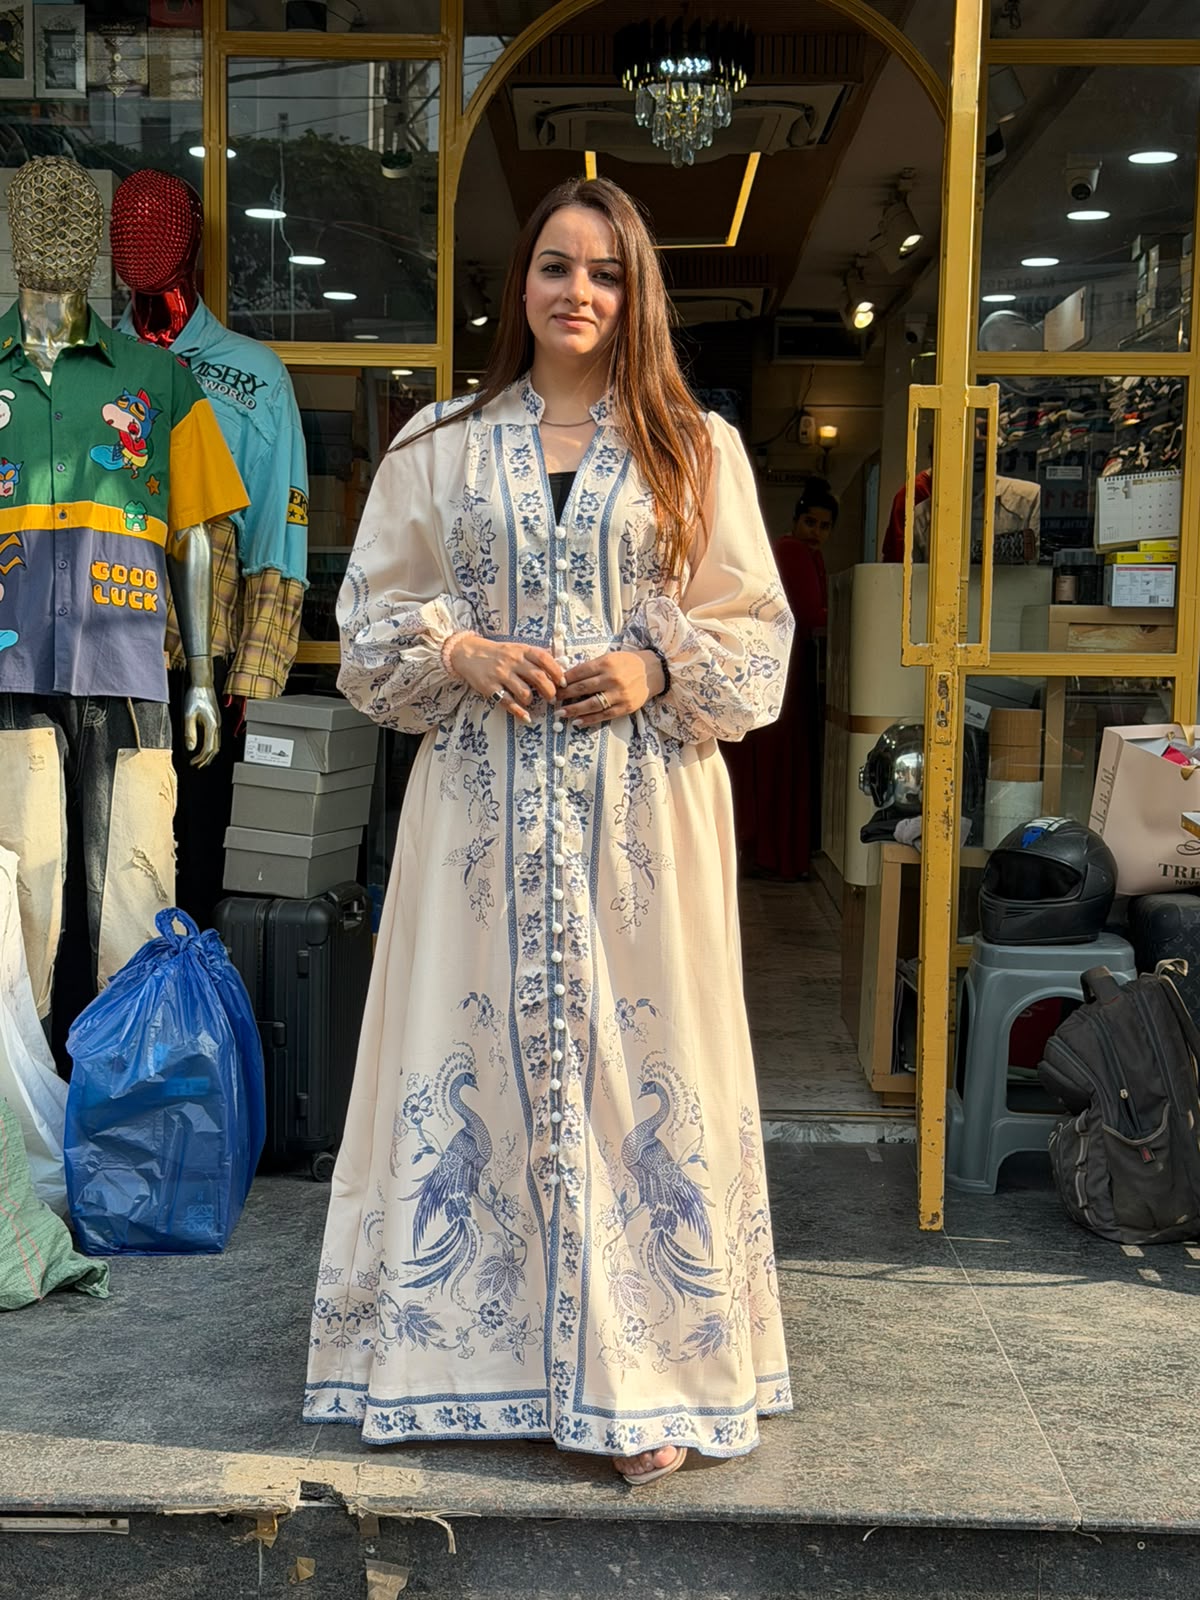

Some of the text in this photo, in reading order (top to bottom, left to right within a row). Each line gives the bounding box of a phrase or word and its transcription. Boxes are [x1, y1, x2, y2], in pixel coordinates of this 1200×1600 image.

[204, 379, 257, 411] WORLD
[90, 560, 159, 591] GOOD
[92, 583, 159, 613] LUCK
[1158, 862, 1200, 880] TRE
